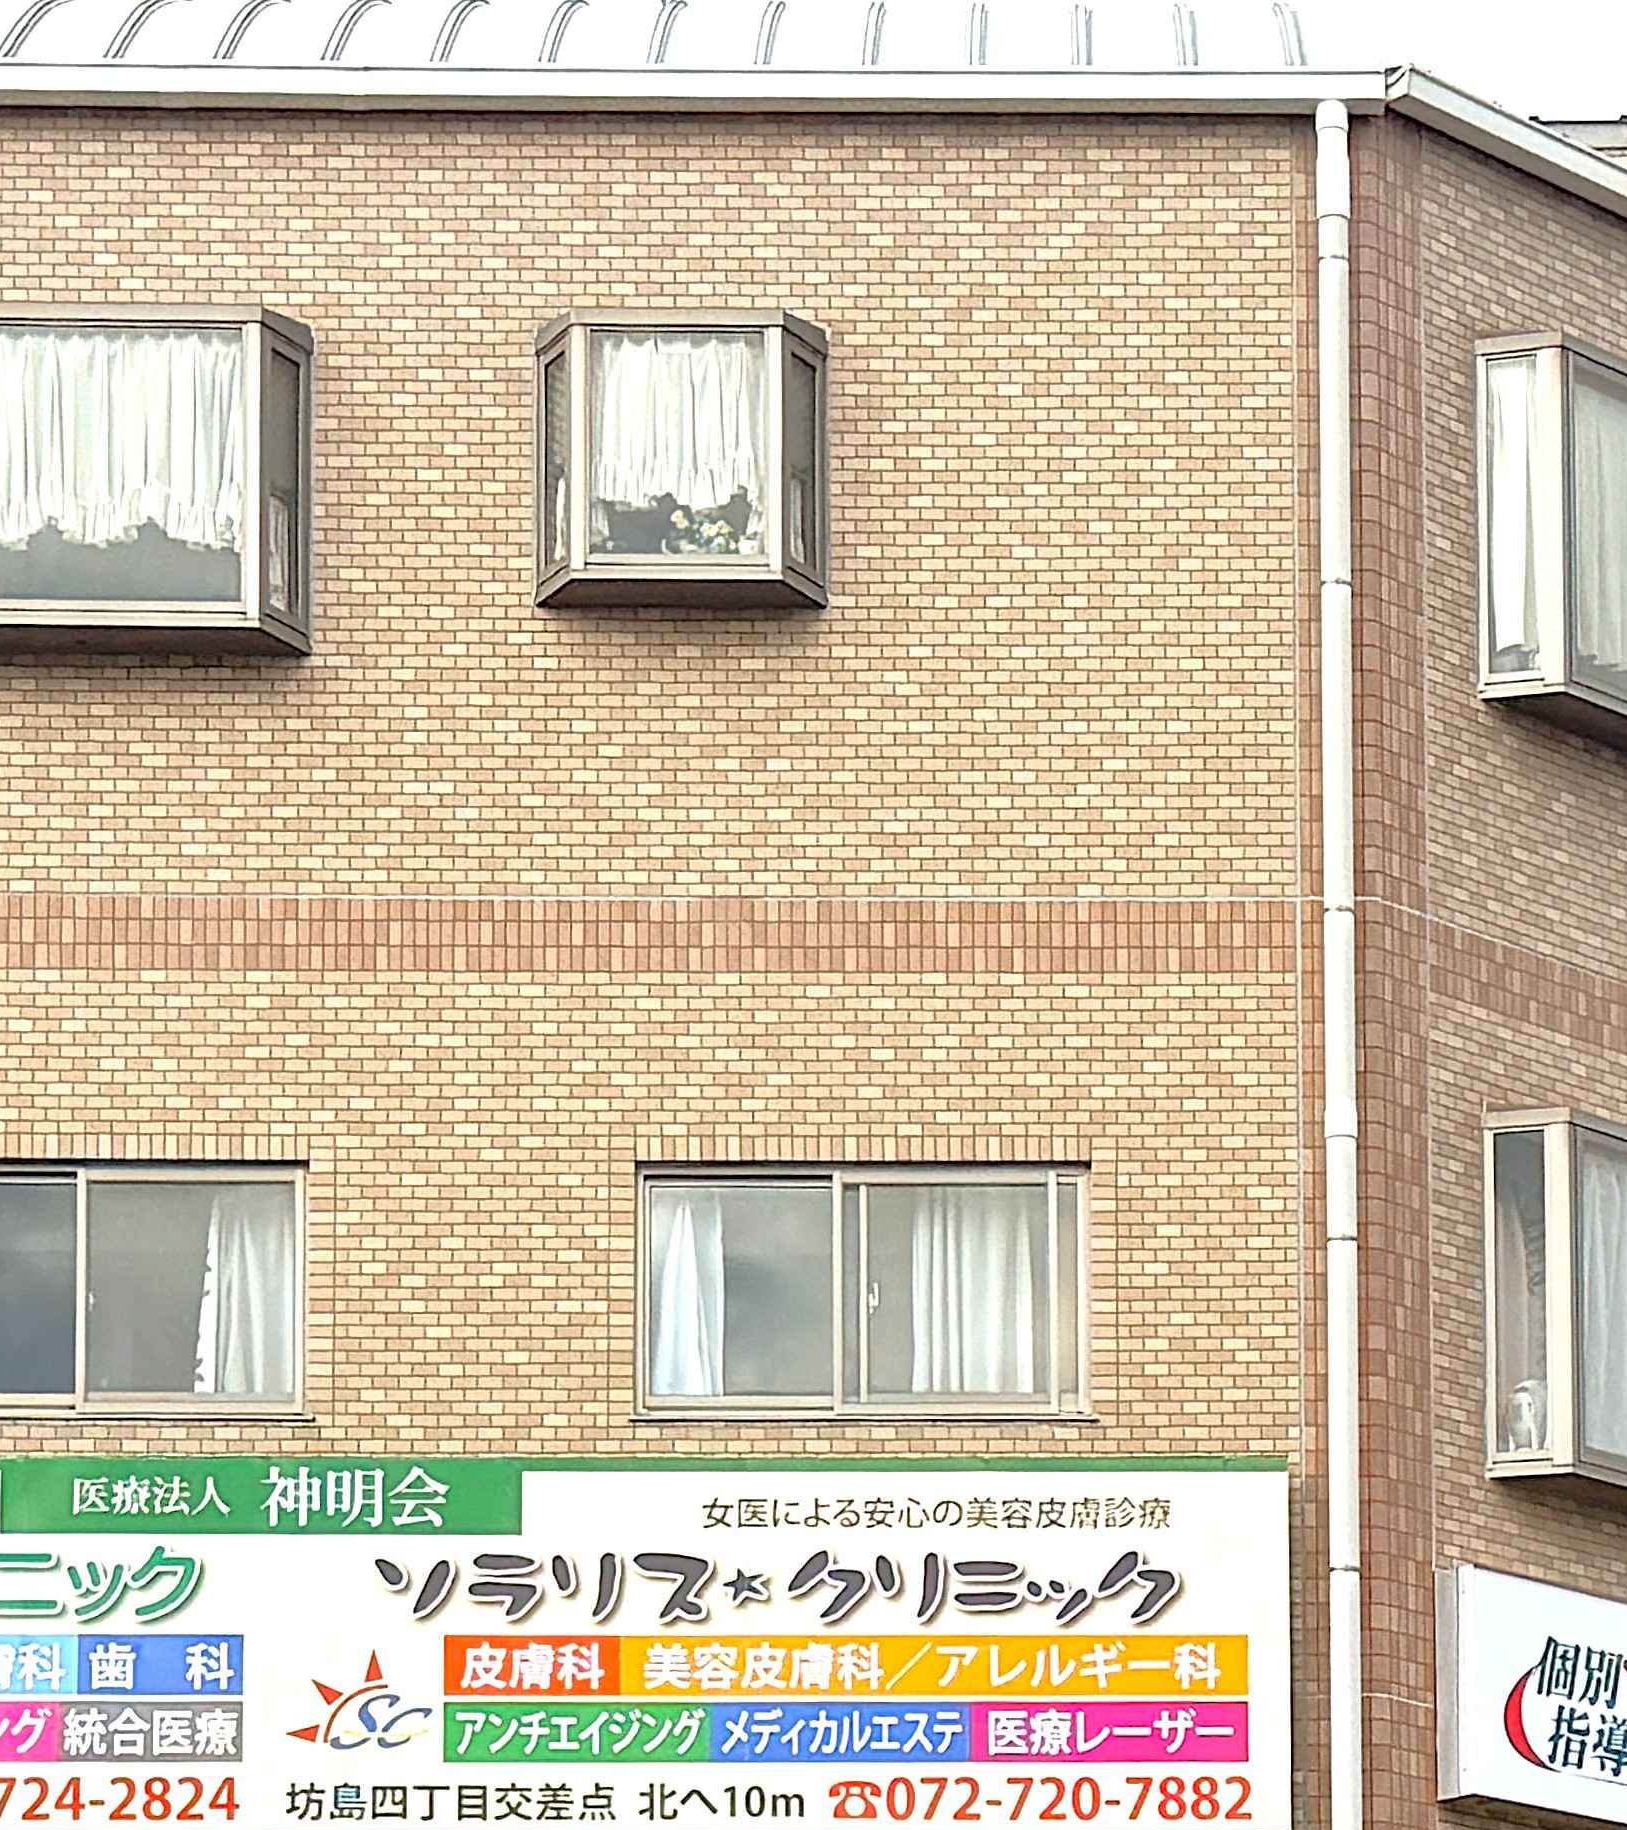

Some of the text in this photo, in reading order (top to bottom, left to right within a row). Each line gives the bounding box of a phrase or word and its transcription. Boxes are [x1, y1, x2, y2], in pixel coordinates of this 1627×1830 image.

[72, 1466, 448, 1528] 医療法人 神明会
[703, 1496, 1172, 1531] 女医による安心の美容皮膚診療
[87, 1642, 235, 1690] 歯科
[460, 1641, 605, 1691] 皮膚科
[1536, 1635, 1627, 1706] 個別
[62, 1708, 240, 1758] 統合医療
[453, 1709, 706, 1755] アンチエイジング
[720, 1707, 967, 1755] メディカルエステ
[986, 1709, 1235, 1757] 医療レーザー
[285, 1782, 617, 1825] 坊島四丁目交差点
[887, 1775, 1254, 1824] 072-720-7882
